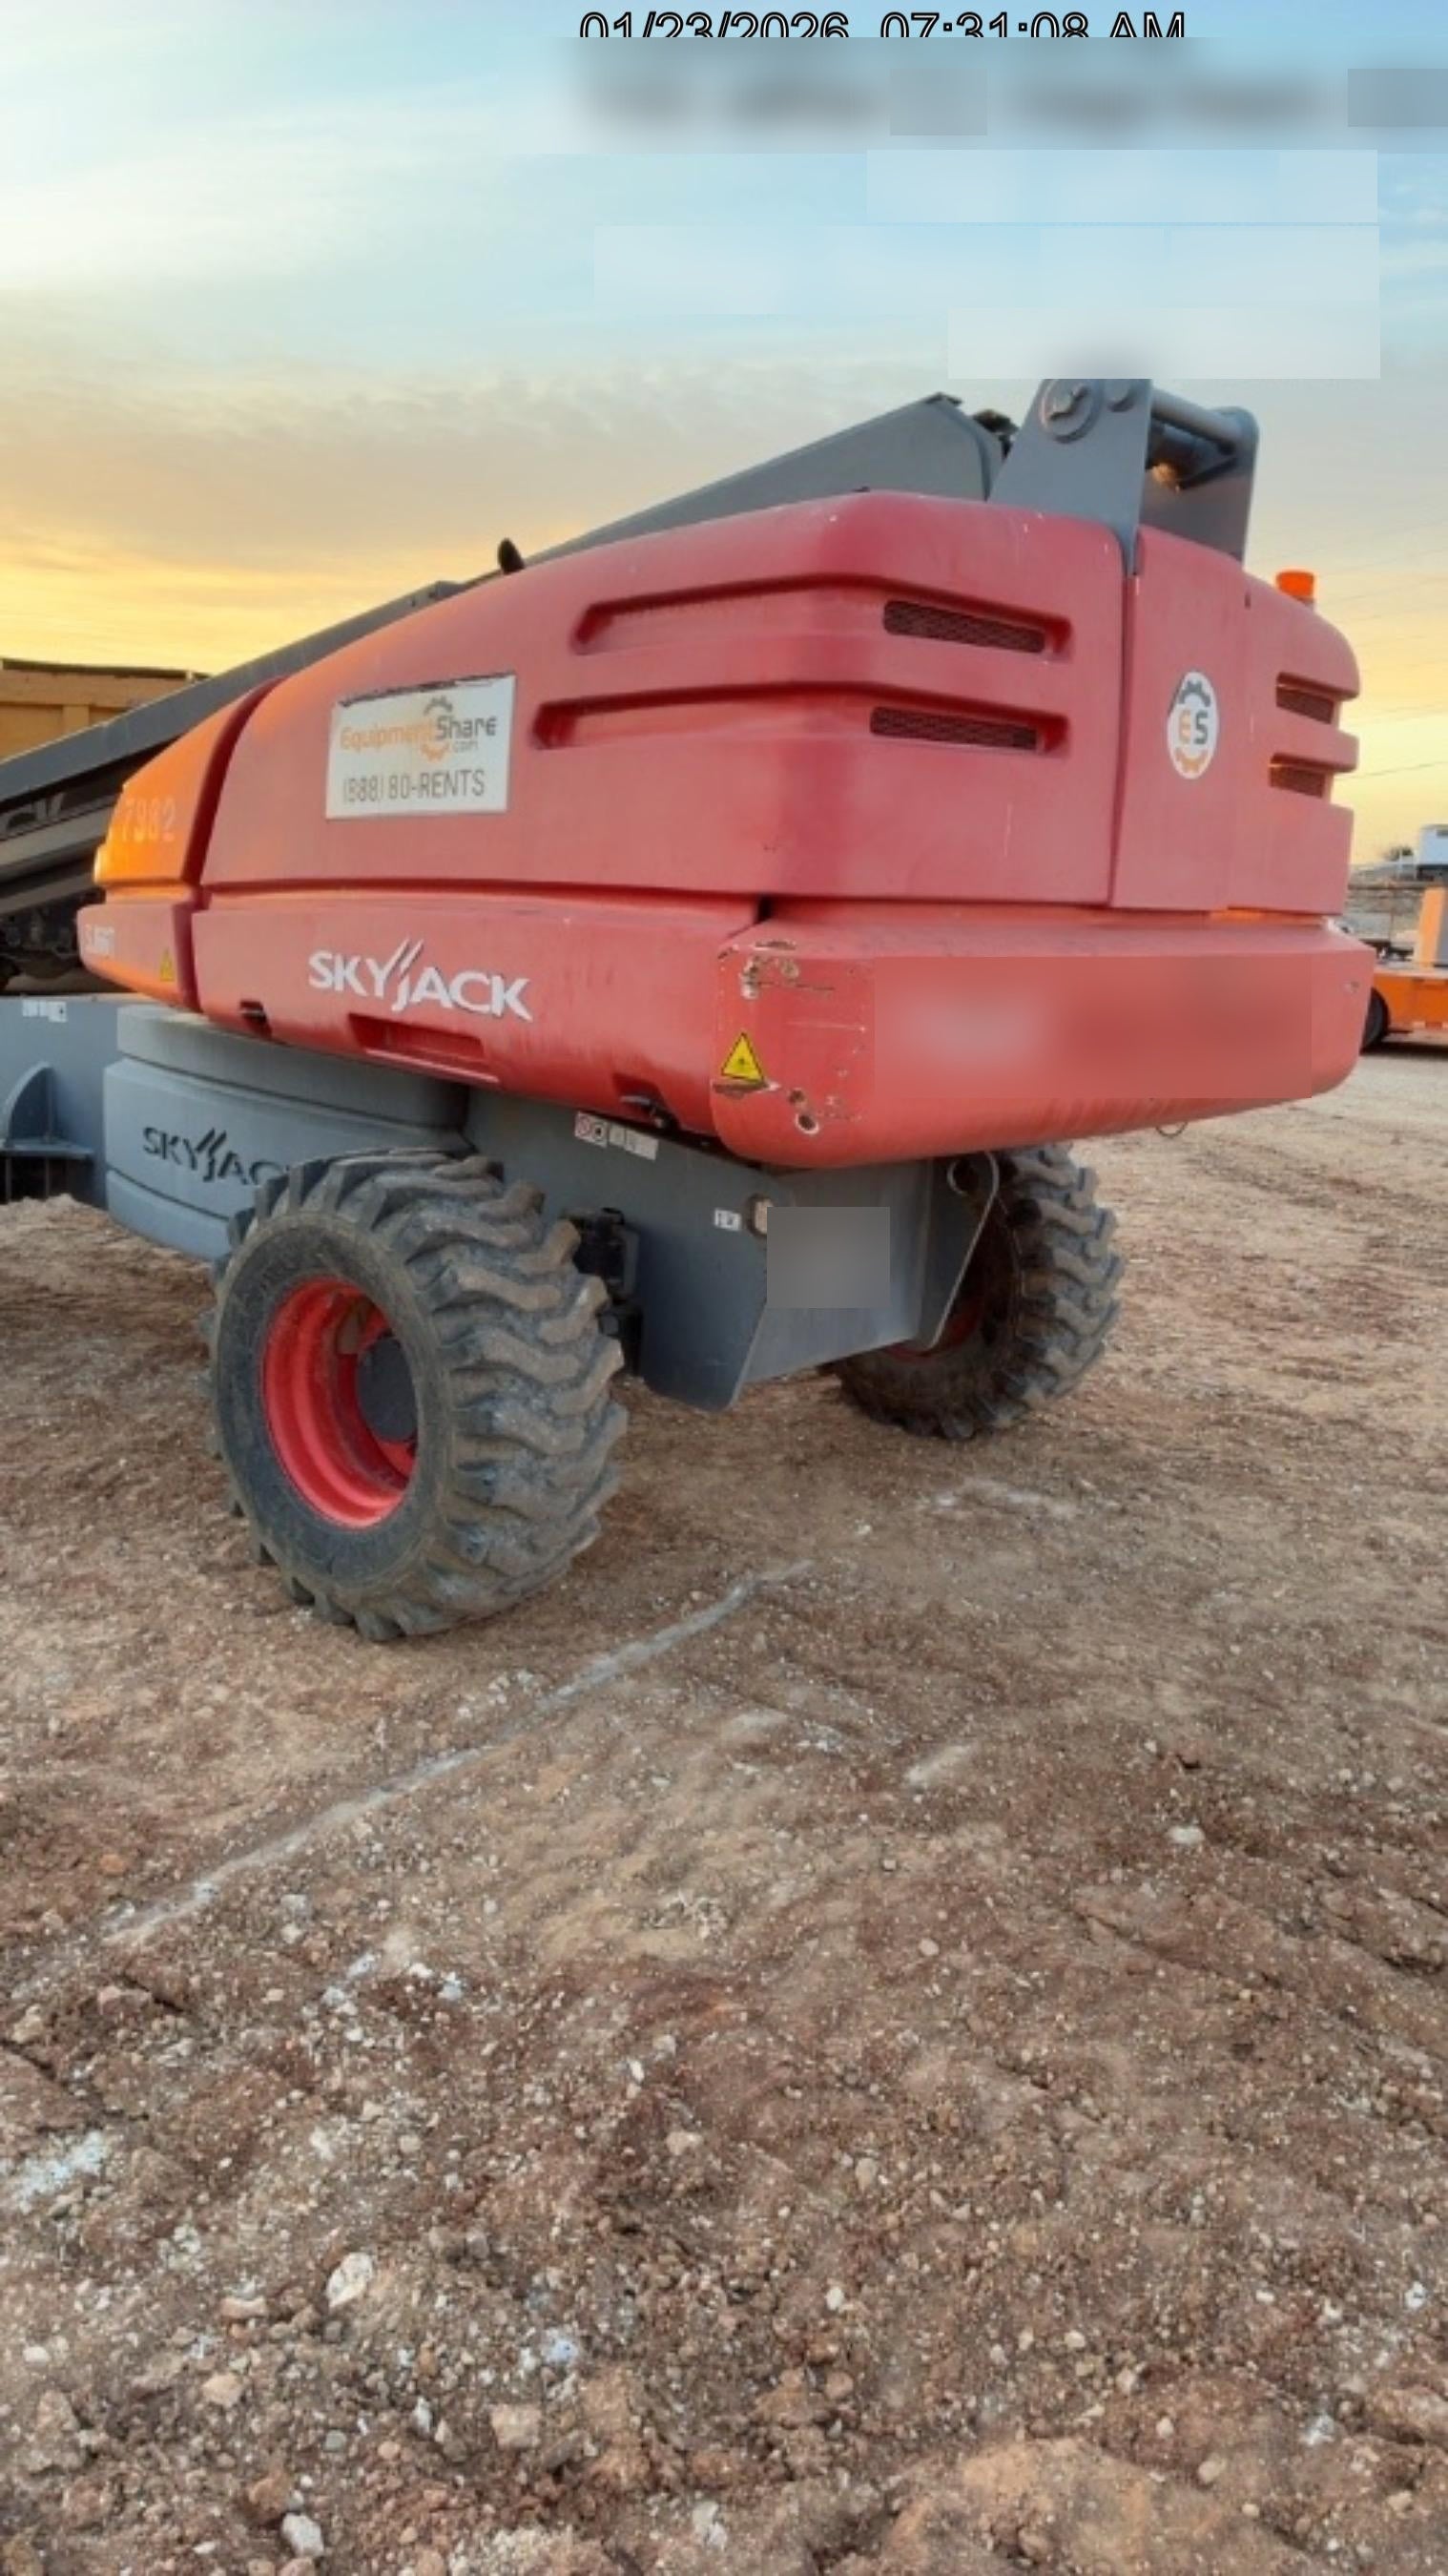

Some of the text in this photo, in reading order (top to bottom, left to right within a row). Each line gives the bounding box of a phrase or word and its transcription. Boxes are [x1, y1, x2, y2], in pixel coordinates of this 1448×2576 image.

[387, 768, 486, 801] 80-RENTS
[308, 938, 532, 1022] SKYJACK
[143, 1127, 290, 1186] SKYJAC
